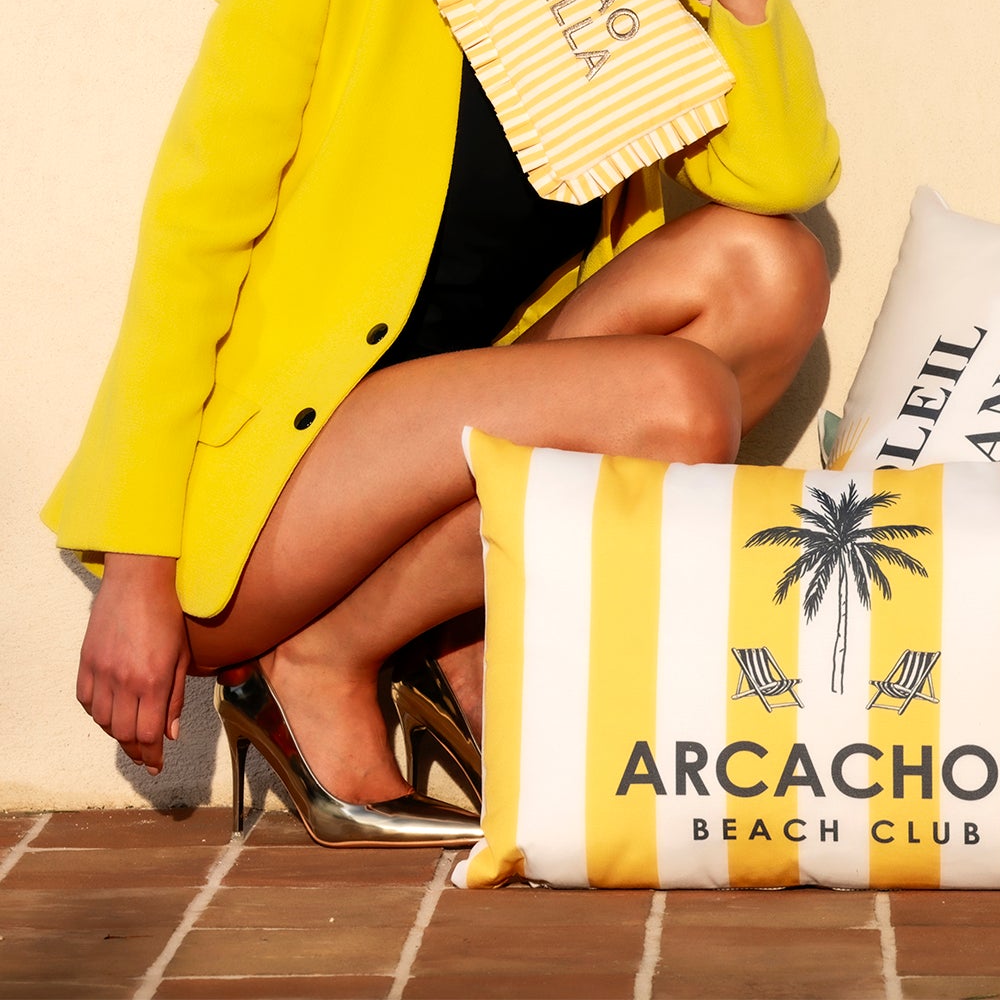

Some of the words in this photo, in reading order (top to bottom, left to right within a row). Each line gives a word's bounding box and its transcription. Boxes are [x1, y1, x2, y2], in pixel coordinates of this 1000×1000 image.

[875, 326, 988, 471] LEIL
[692, 818, 839, 842] BEACH
[871, 819, 981, 845] CLUB
